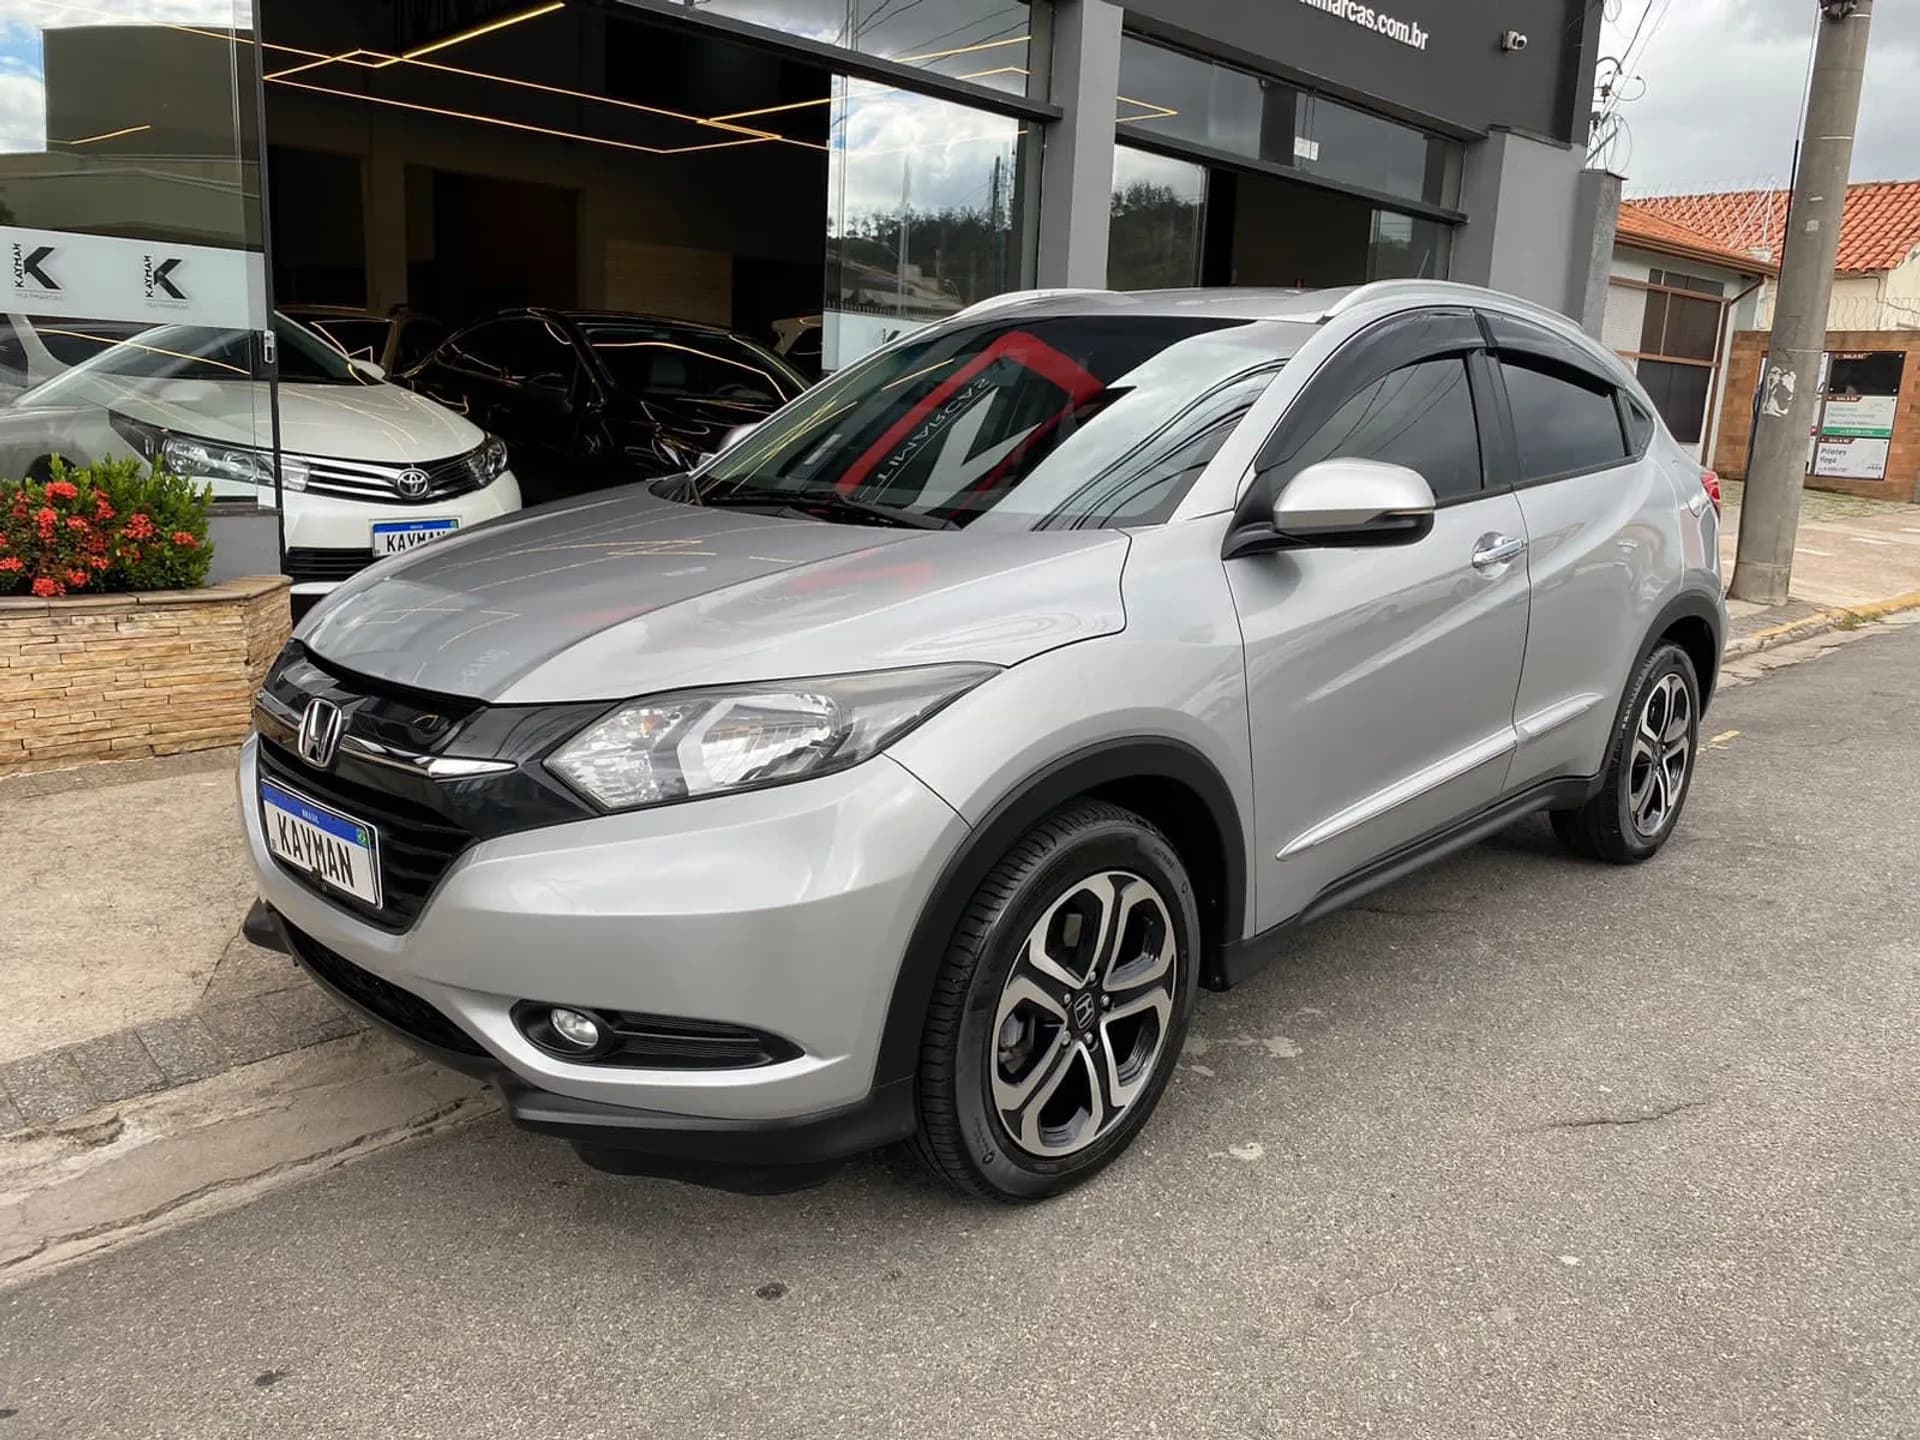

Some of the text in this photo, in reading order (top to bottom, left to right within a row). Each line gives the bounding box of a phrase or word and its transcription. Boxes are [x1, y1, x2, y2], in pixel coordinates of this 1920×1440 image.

[1299, 0, 1428, 49] marcas.com.br
[12, 243, 24, 288] KAYMAN
[144, 256, 154, 298] KAYMAN
[386, 530, 446, 553] KAYM
[277, 812, 355, 888] KAYMAN
